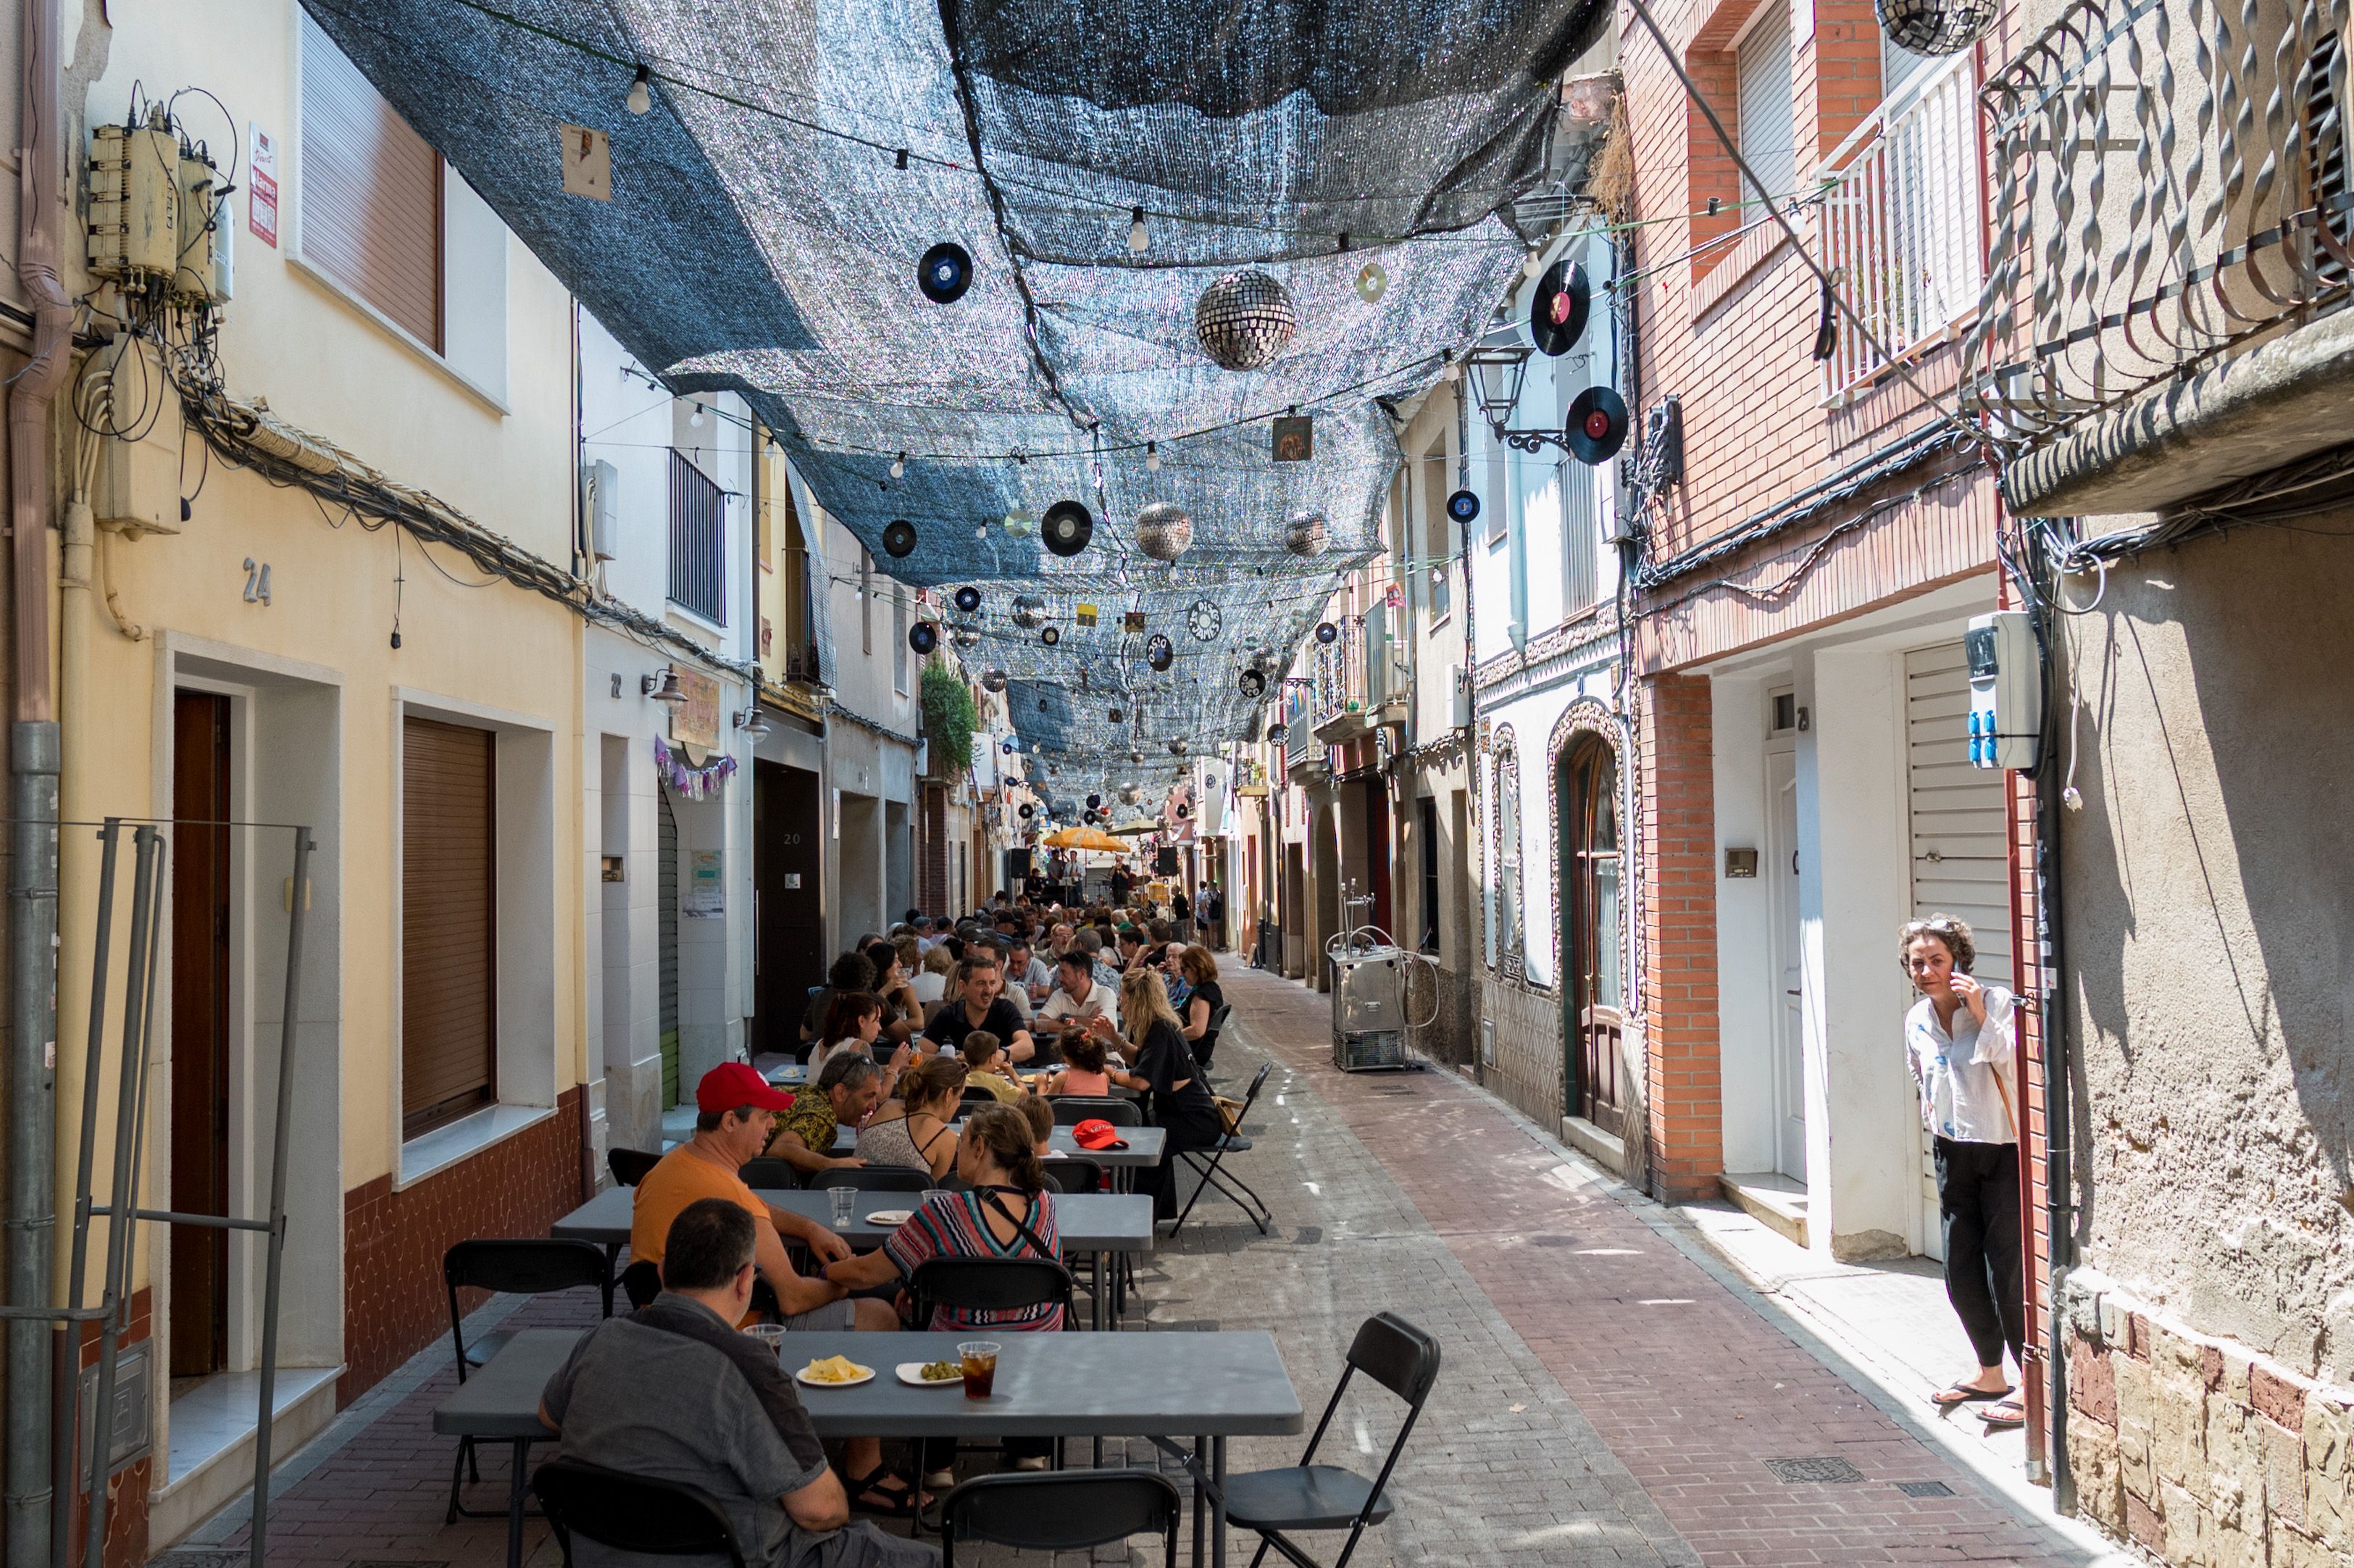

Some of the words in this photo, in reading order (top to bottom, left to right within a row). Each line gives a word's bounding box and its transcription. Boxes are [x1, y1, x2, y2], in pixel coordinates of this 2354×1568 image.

[243, 557, 271, 606] 24
[611, 672, 622, 699] 22
[784, 833, 801, 845] 20
